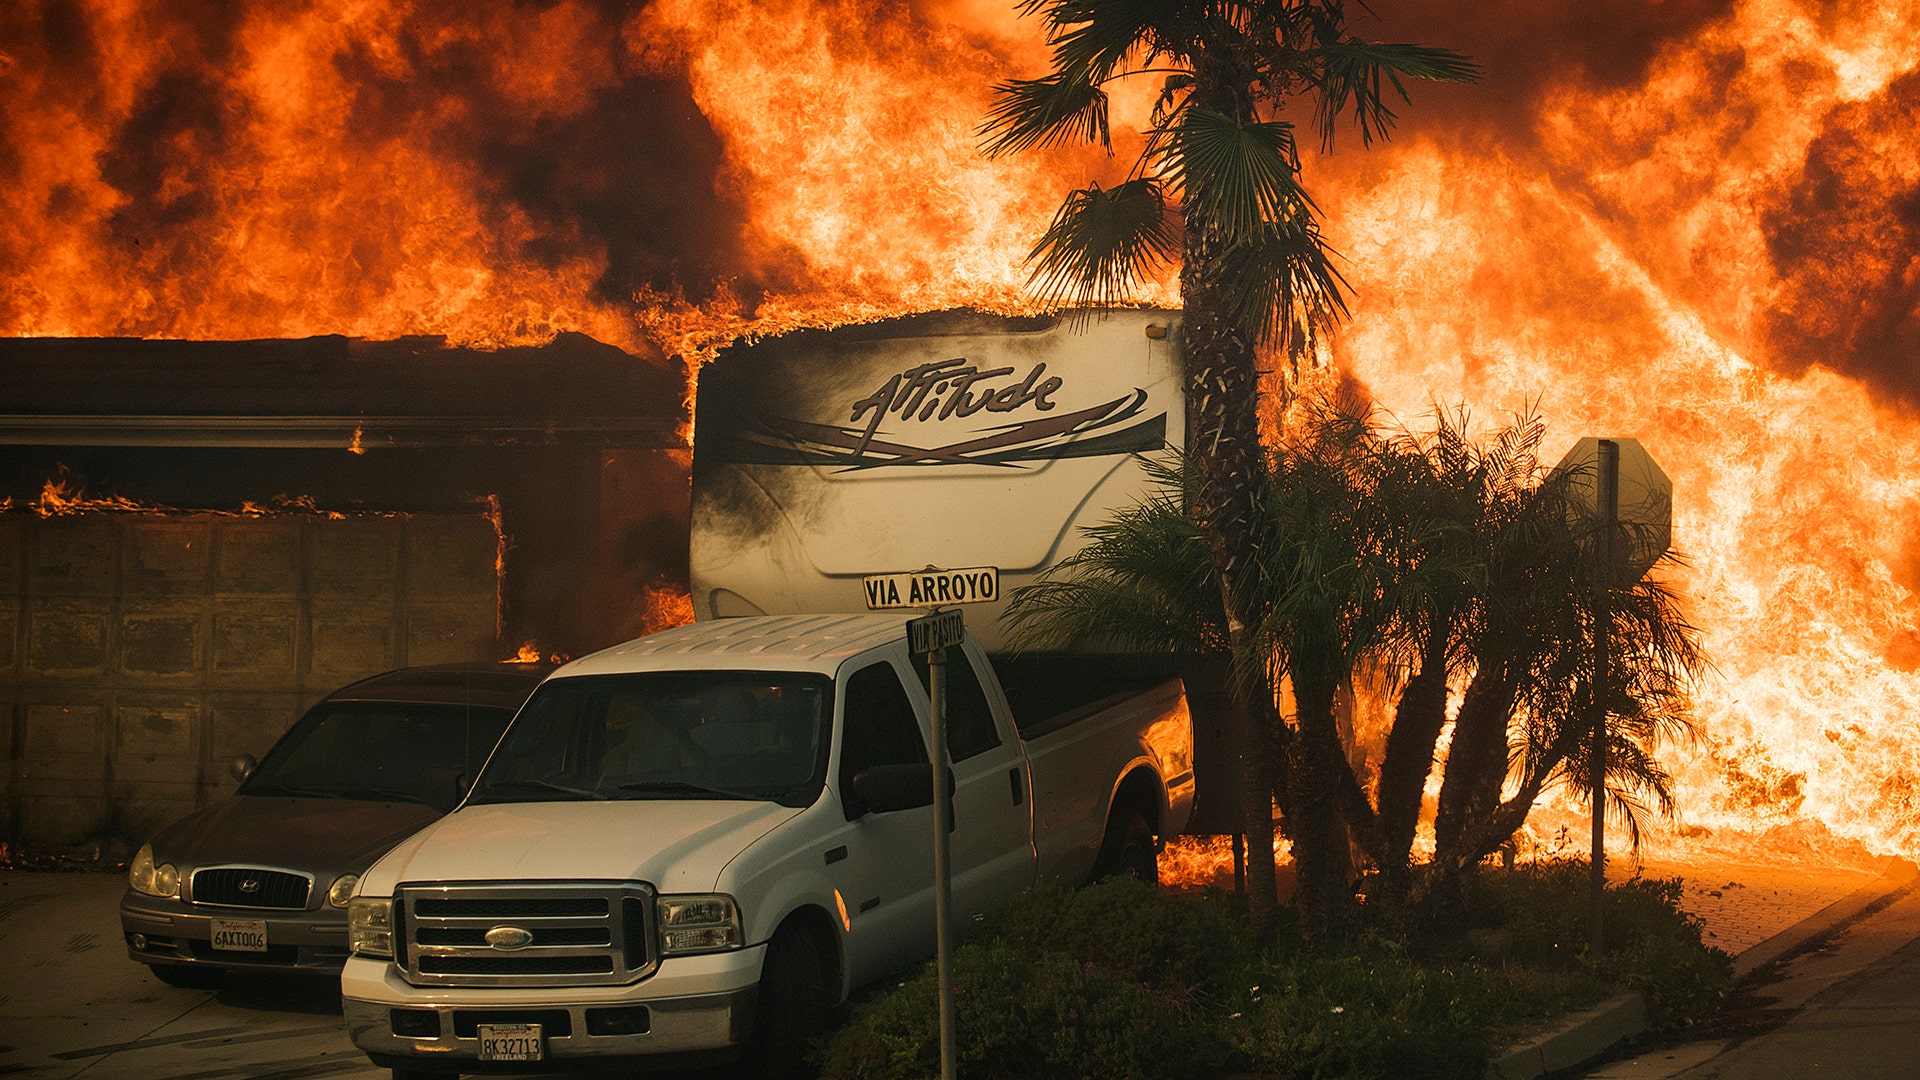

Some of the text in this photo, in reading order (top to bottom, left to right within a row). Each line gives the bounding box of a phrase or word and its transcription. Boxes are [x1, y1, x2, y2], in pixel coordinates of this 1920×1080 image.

[850, 358, 1062, 458] Attitude
[866, 572, 993, 605] VIA ARROYO
[913, 614, 963, 651] VIA PASITO
[215, 931, 263, 947] 6AXT006
[484, 1038, 539, 1054] 8K32713
